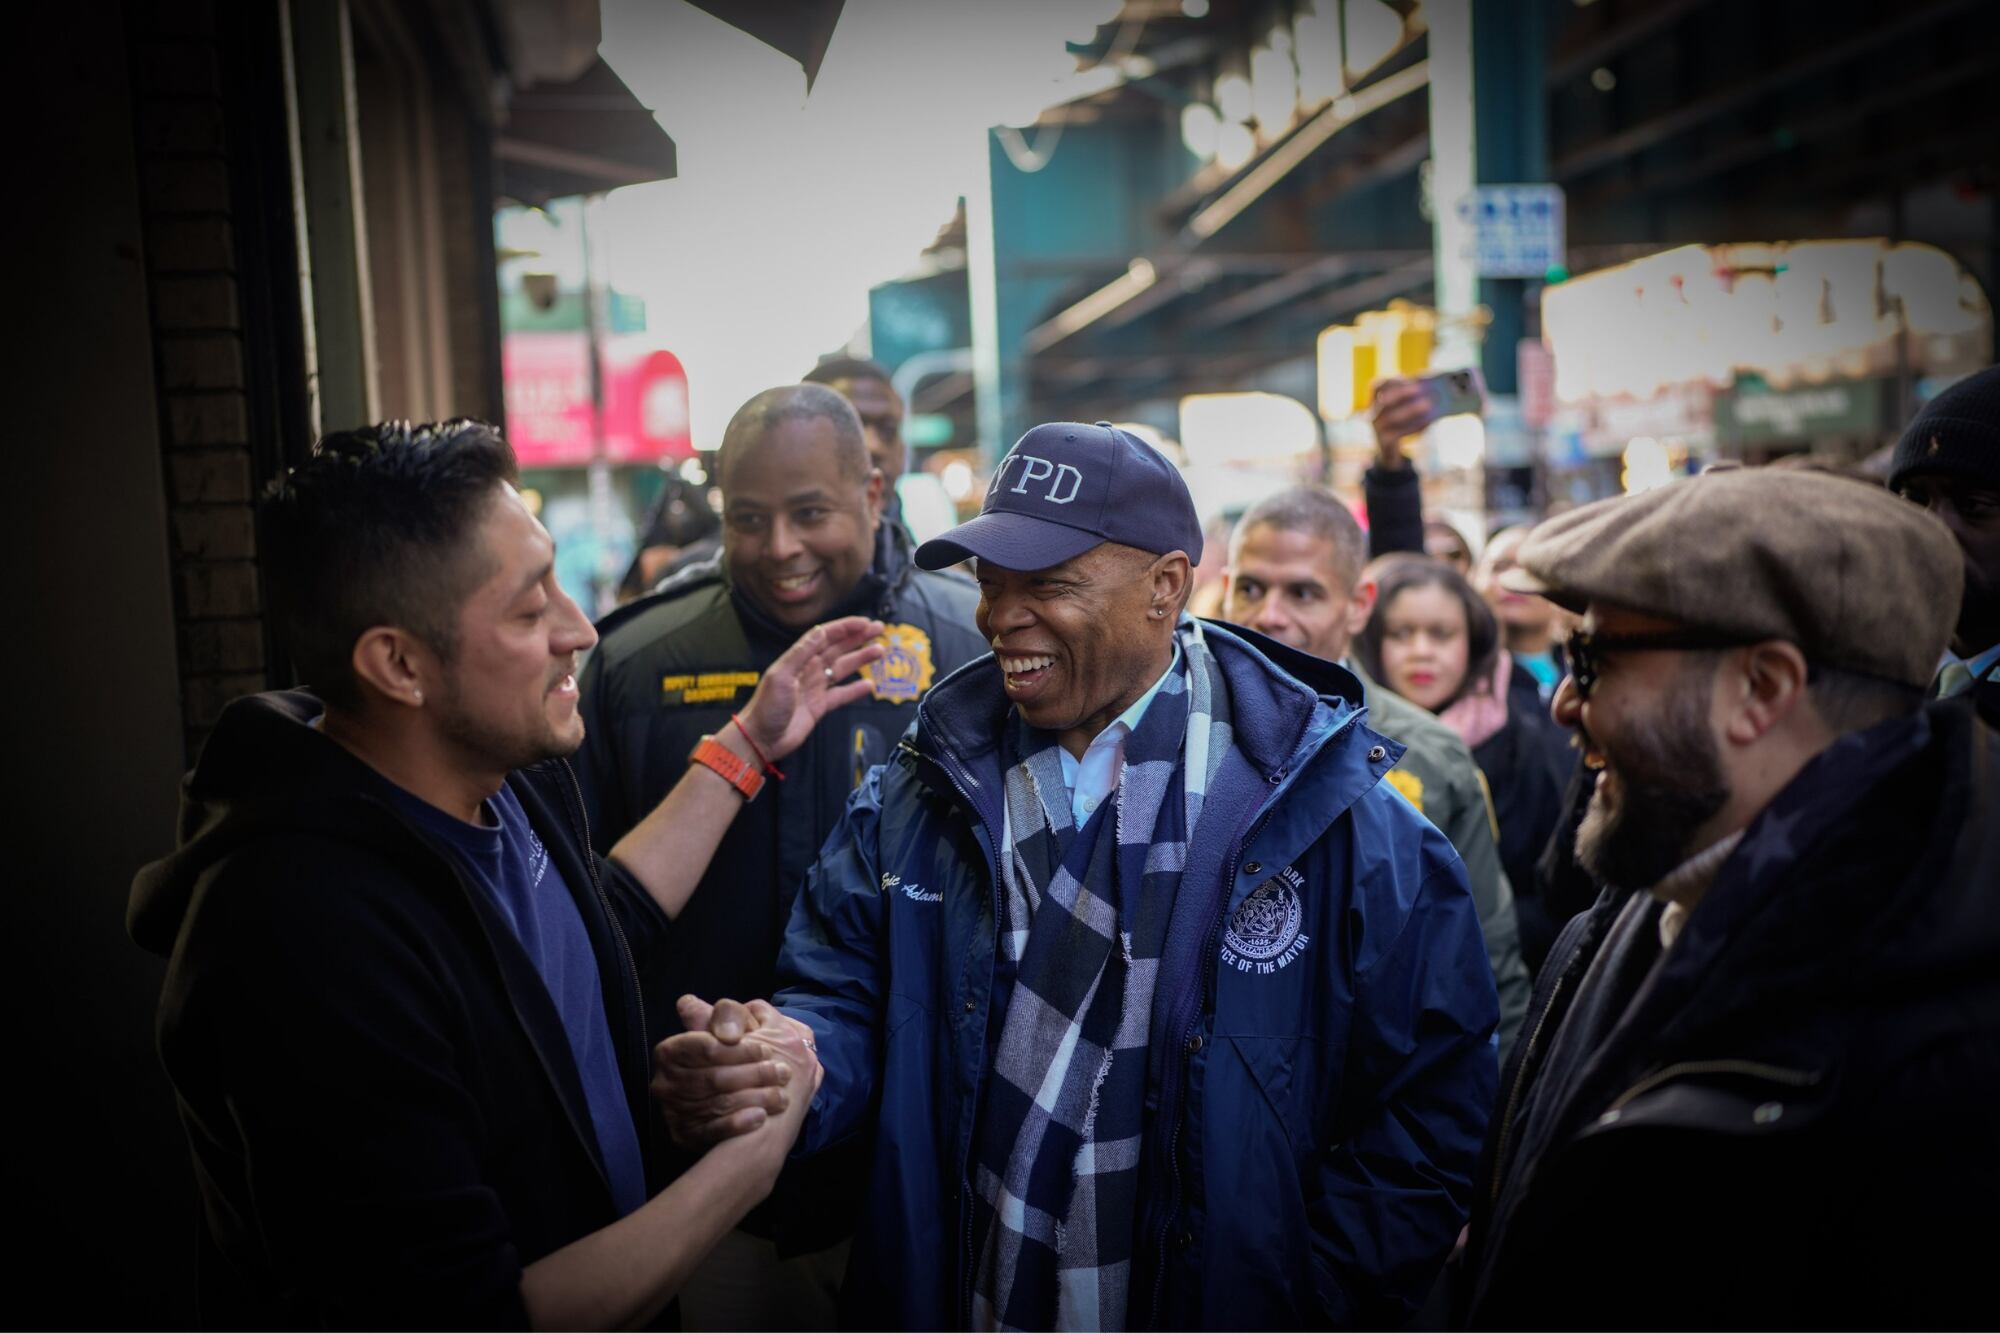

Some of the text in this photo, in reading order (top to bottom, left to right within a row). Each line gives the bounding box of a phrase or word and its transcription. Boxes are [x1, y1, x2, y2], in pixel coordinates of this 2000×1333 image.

[989, 455, 1083, 504] YPD
[1282, 866, 1305, 888] ORK
[1237, 958, 1253, 973] OF
[1256, 961, 1276, 974] THE
[1277, 933, 1310, 969] MAYOR
